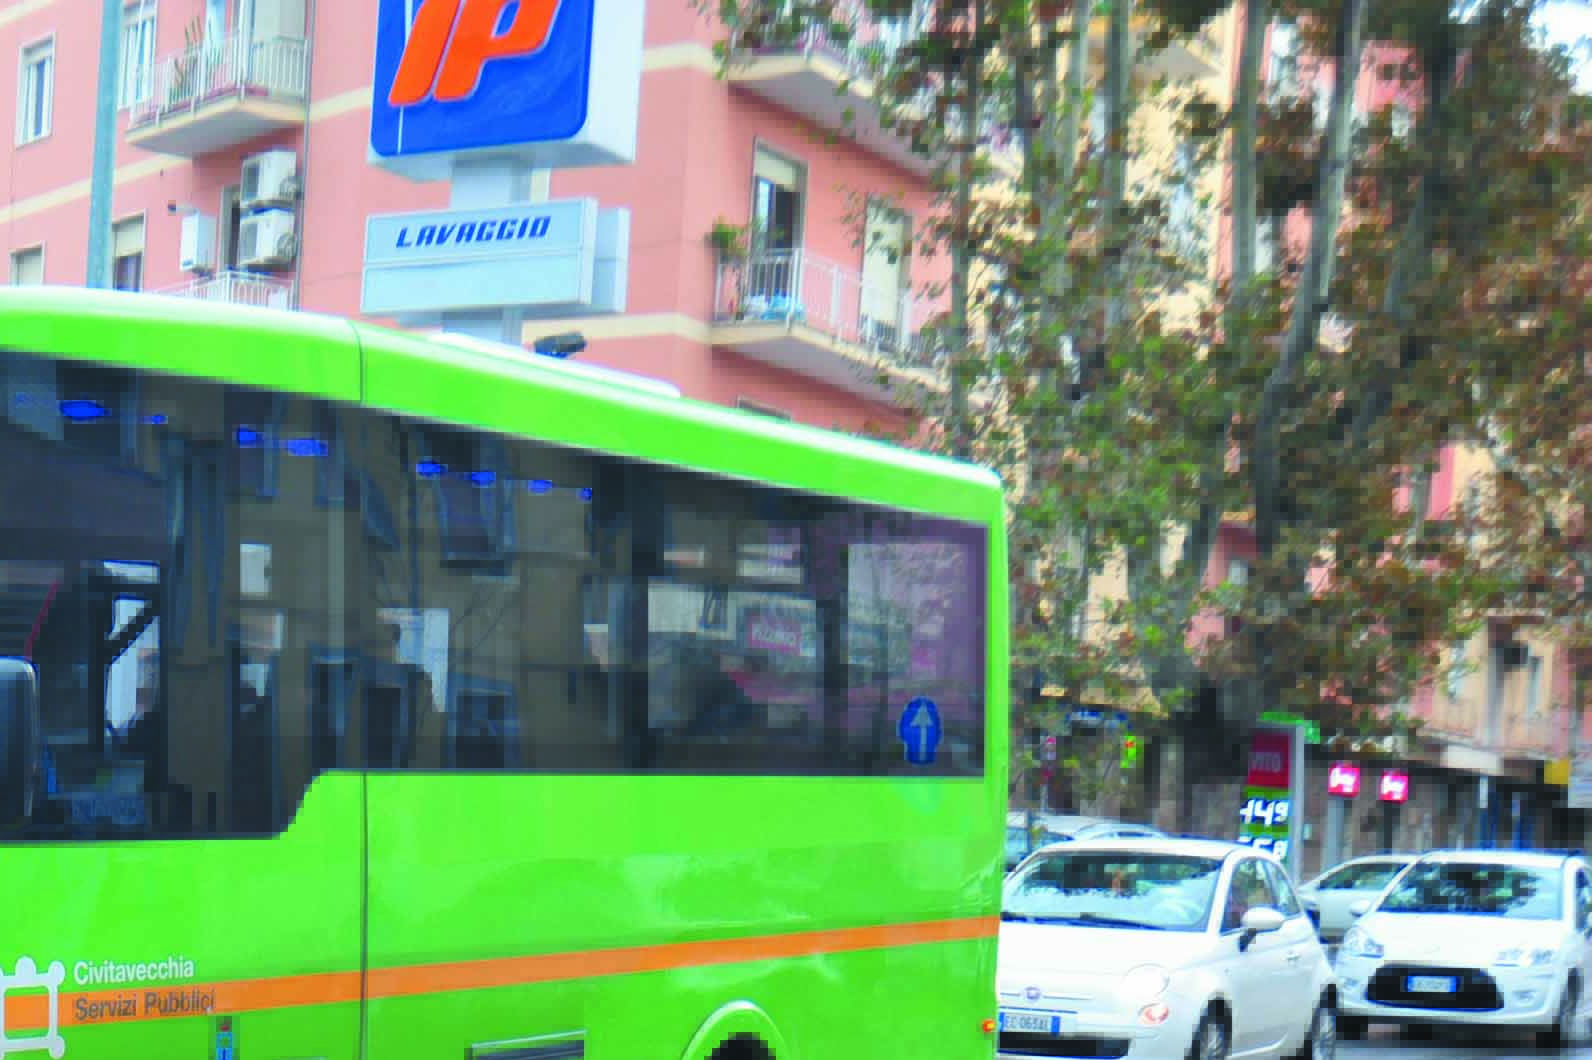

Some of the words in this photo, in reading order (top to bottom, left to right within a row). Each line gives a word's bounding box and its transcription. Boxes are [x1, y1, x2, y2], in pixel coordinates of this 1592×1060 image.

[388, 0, 559, 106] IP
[396, 216, 551, 248] LAVAGGIO
[73, 955, 195, 985] Civitavecchia
[75, 993, 137, 1020] Servizi
[143, 988, 215, 1015] Pubblici
